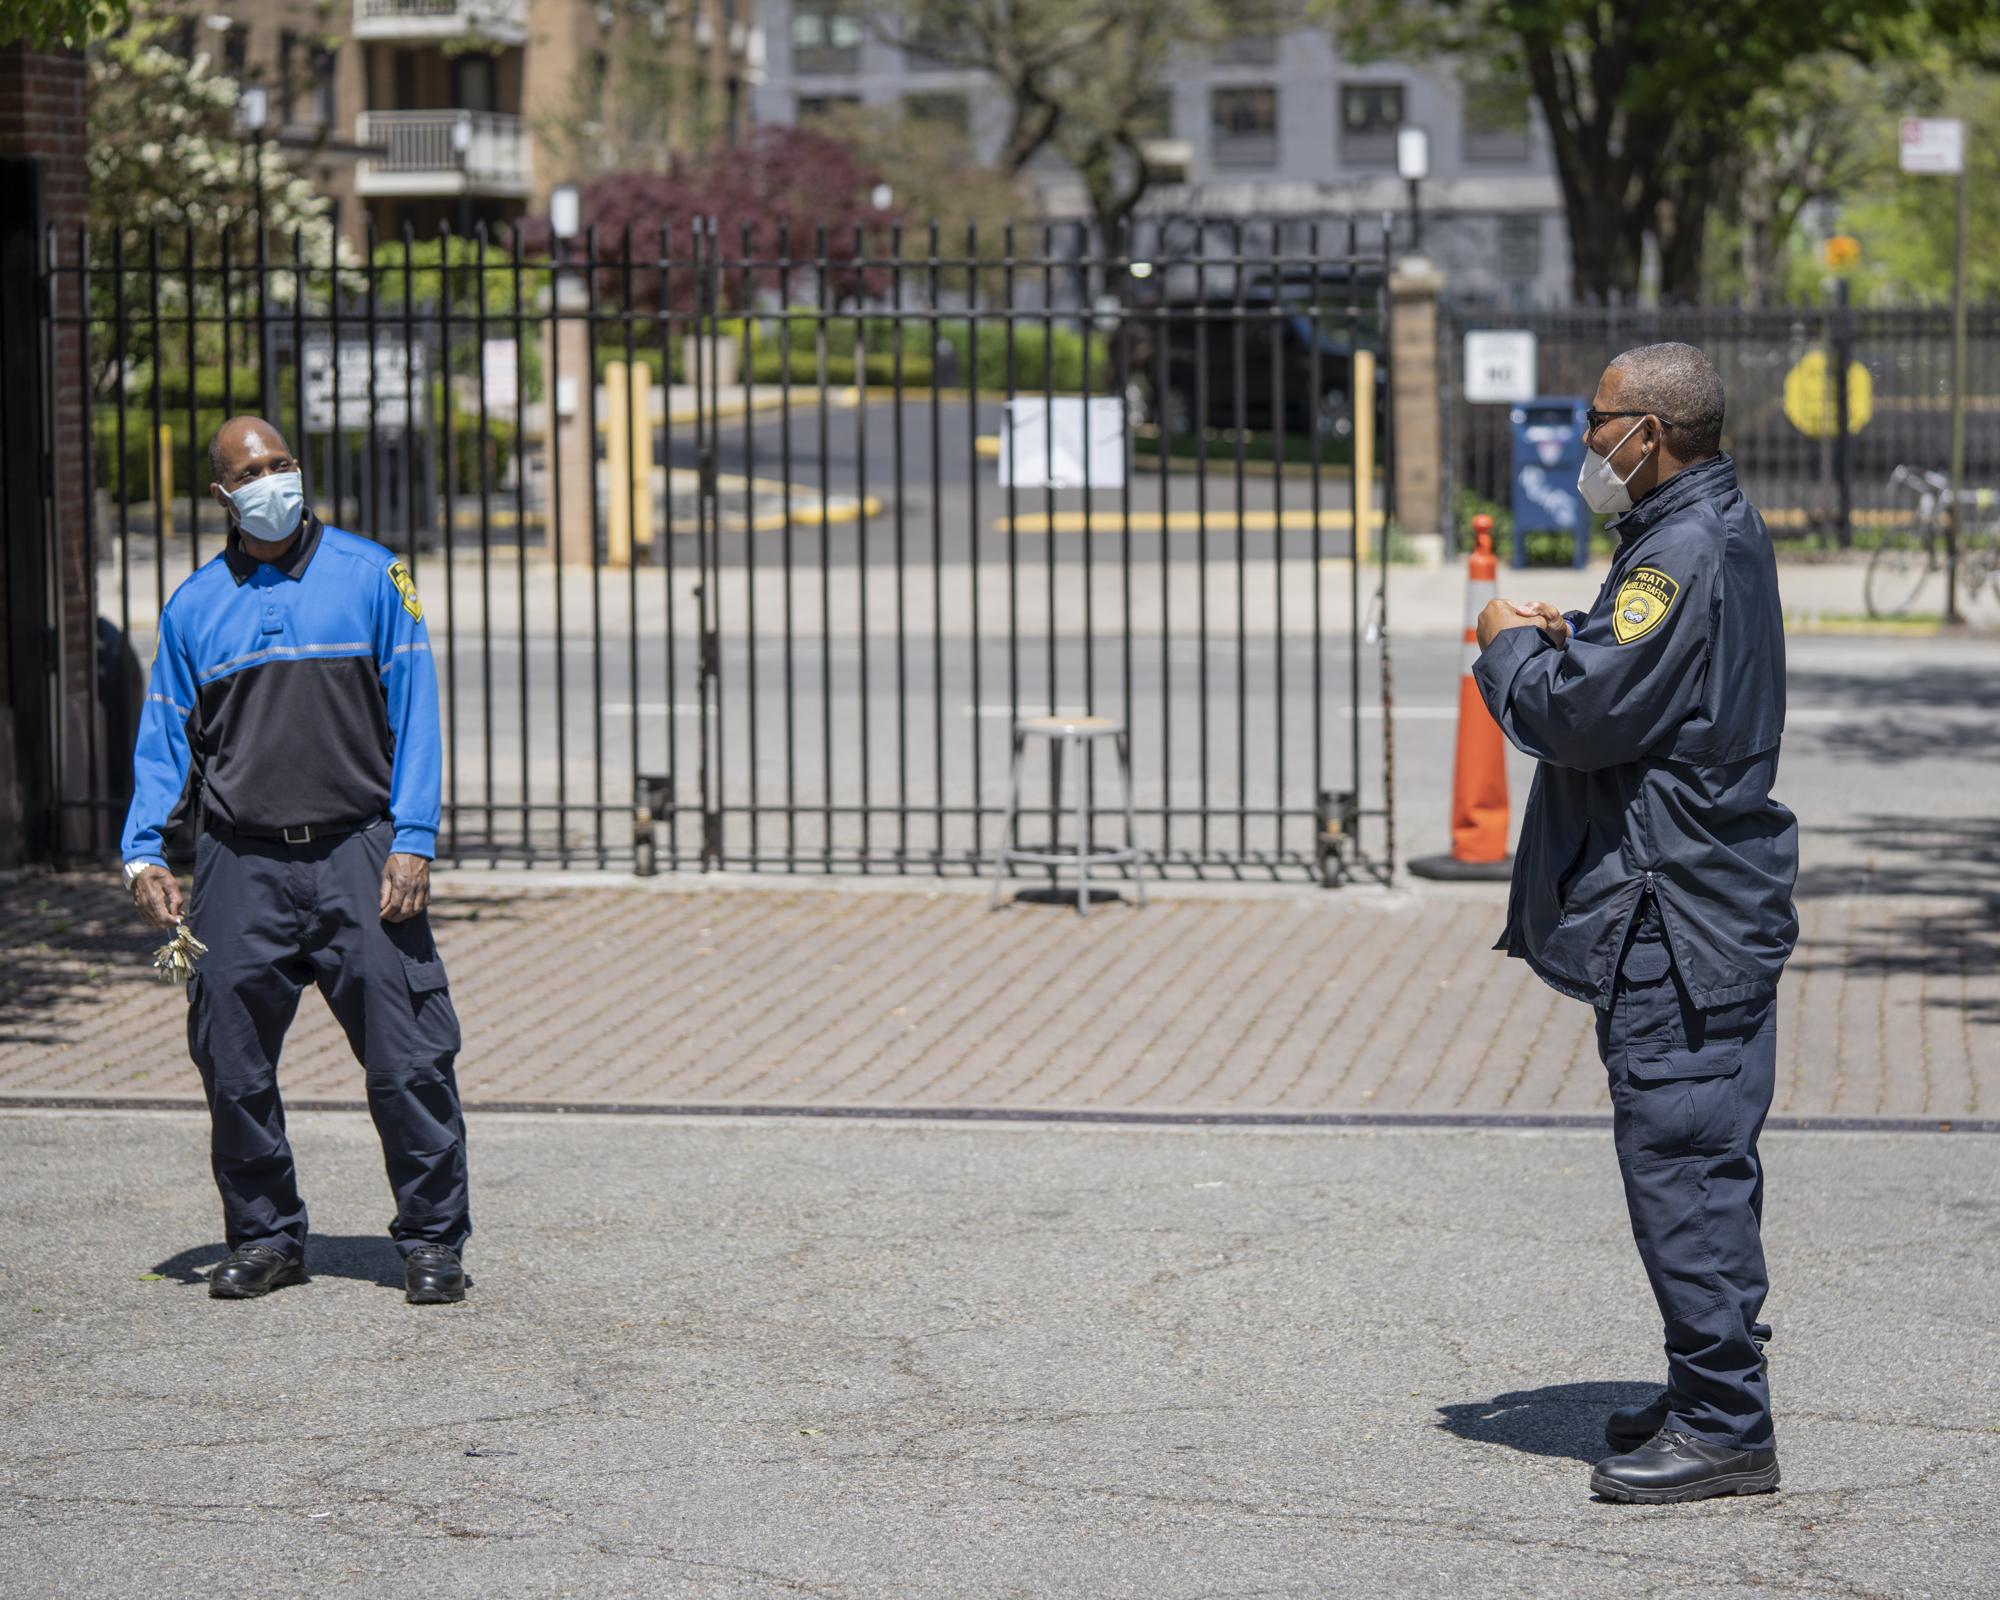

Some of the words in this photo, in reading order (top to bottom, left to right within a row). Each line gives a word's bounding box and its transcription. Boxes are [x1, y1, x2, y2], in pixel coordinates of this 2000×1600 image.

[1635, 572, 1668, 589] PRATT
[1624, 581, 1647, 590] PUBLIC
[1646, 583, 1670, 604] SAFETY
